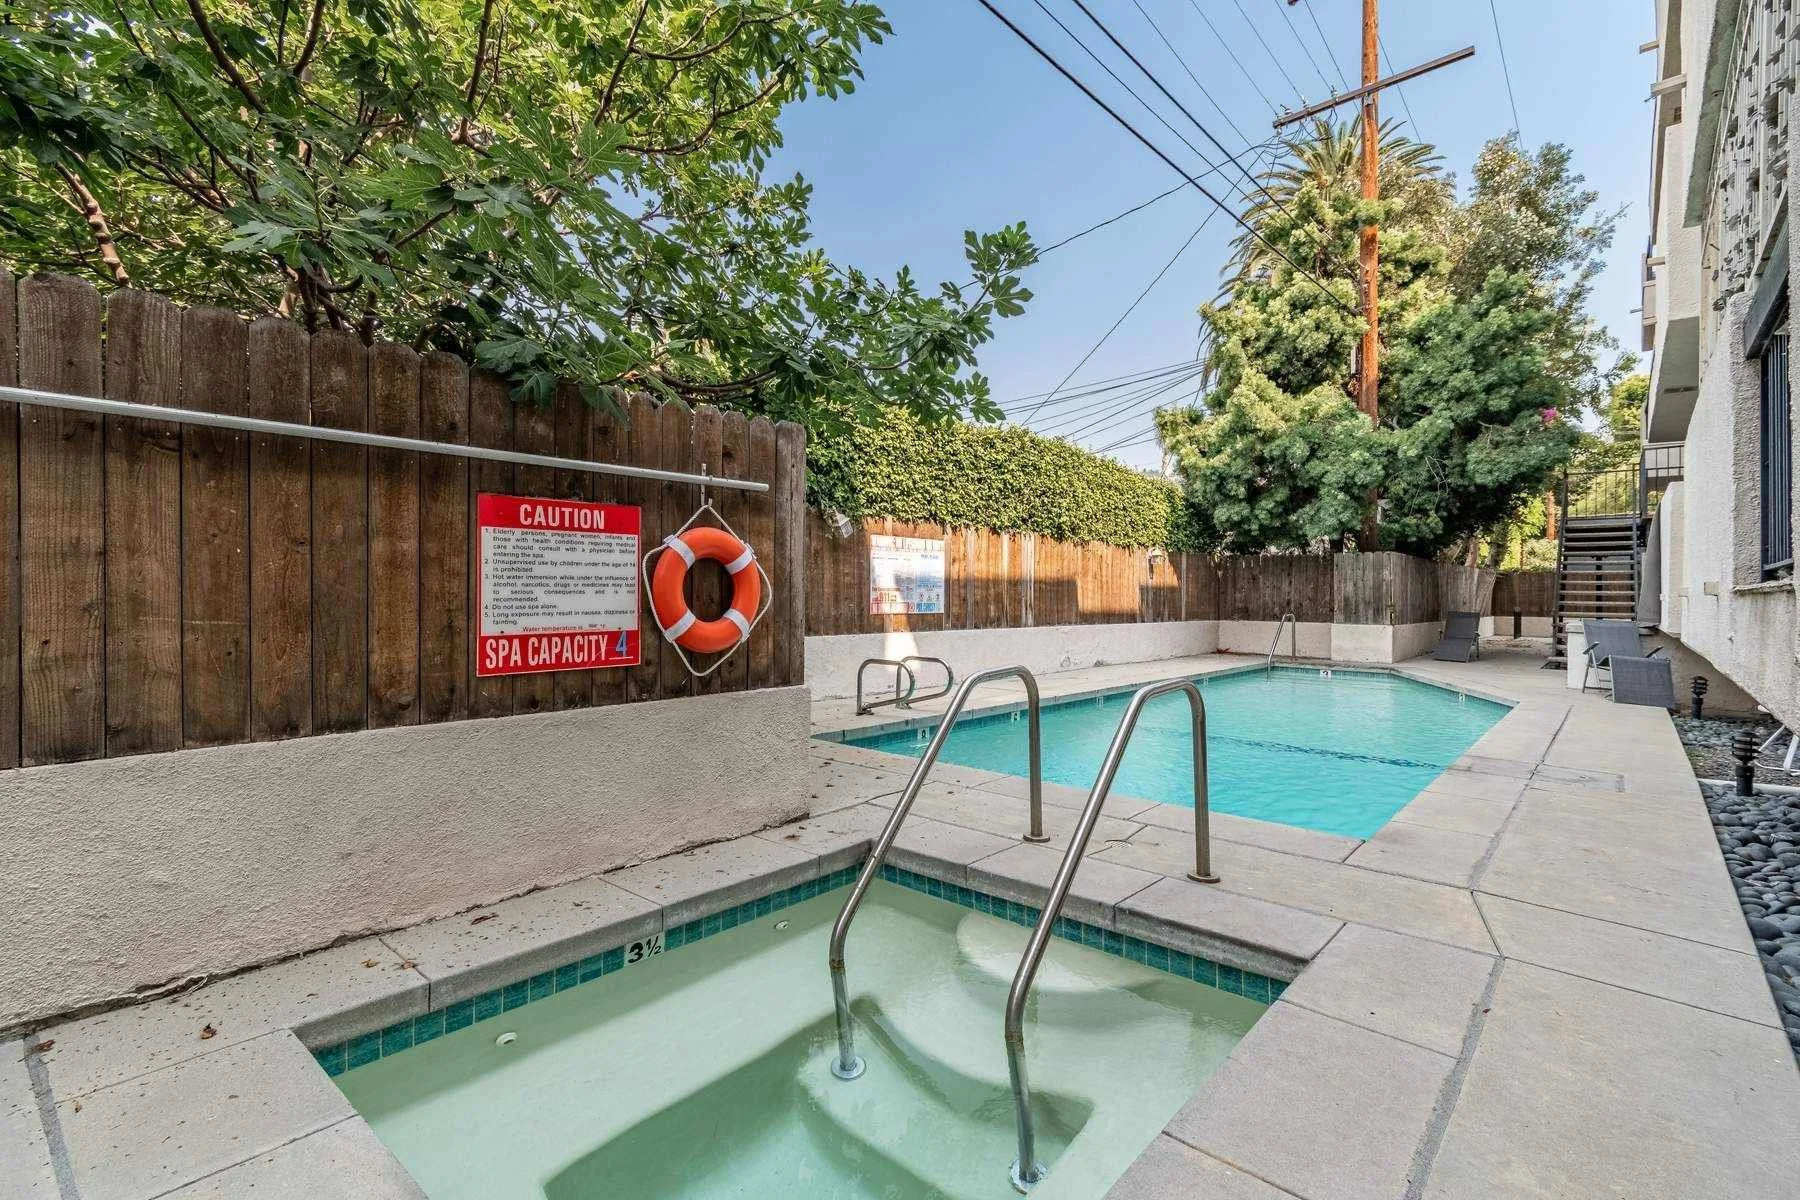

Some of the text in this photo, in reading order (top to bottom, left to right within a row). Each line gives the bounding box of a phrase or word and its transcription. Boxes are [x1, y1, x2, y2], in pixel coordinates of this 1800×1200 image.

[520, 504, 604, 529] CAUTION
[486, 630, 628, 669] SPA CAPACITY 4
